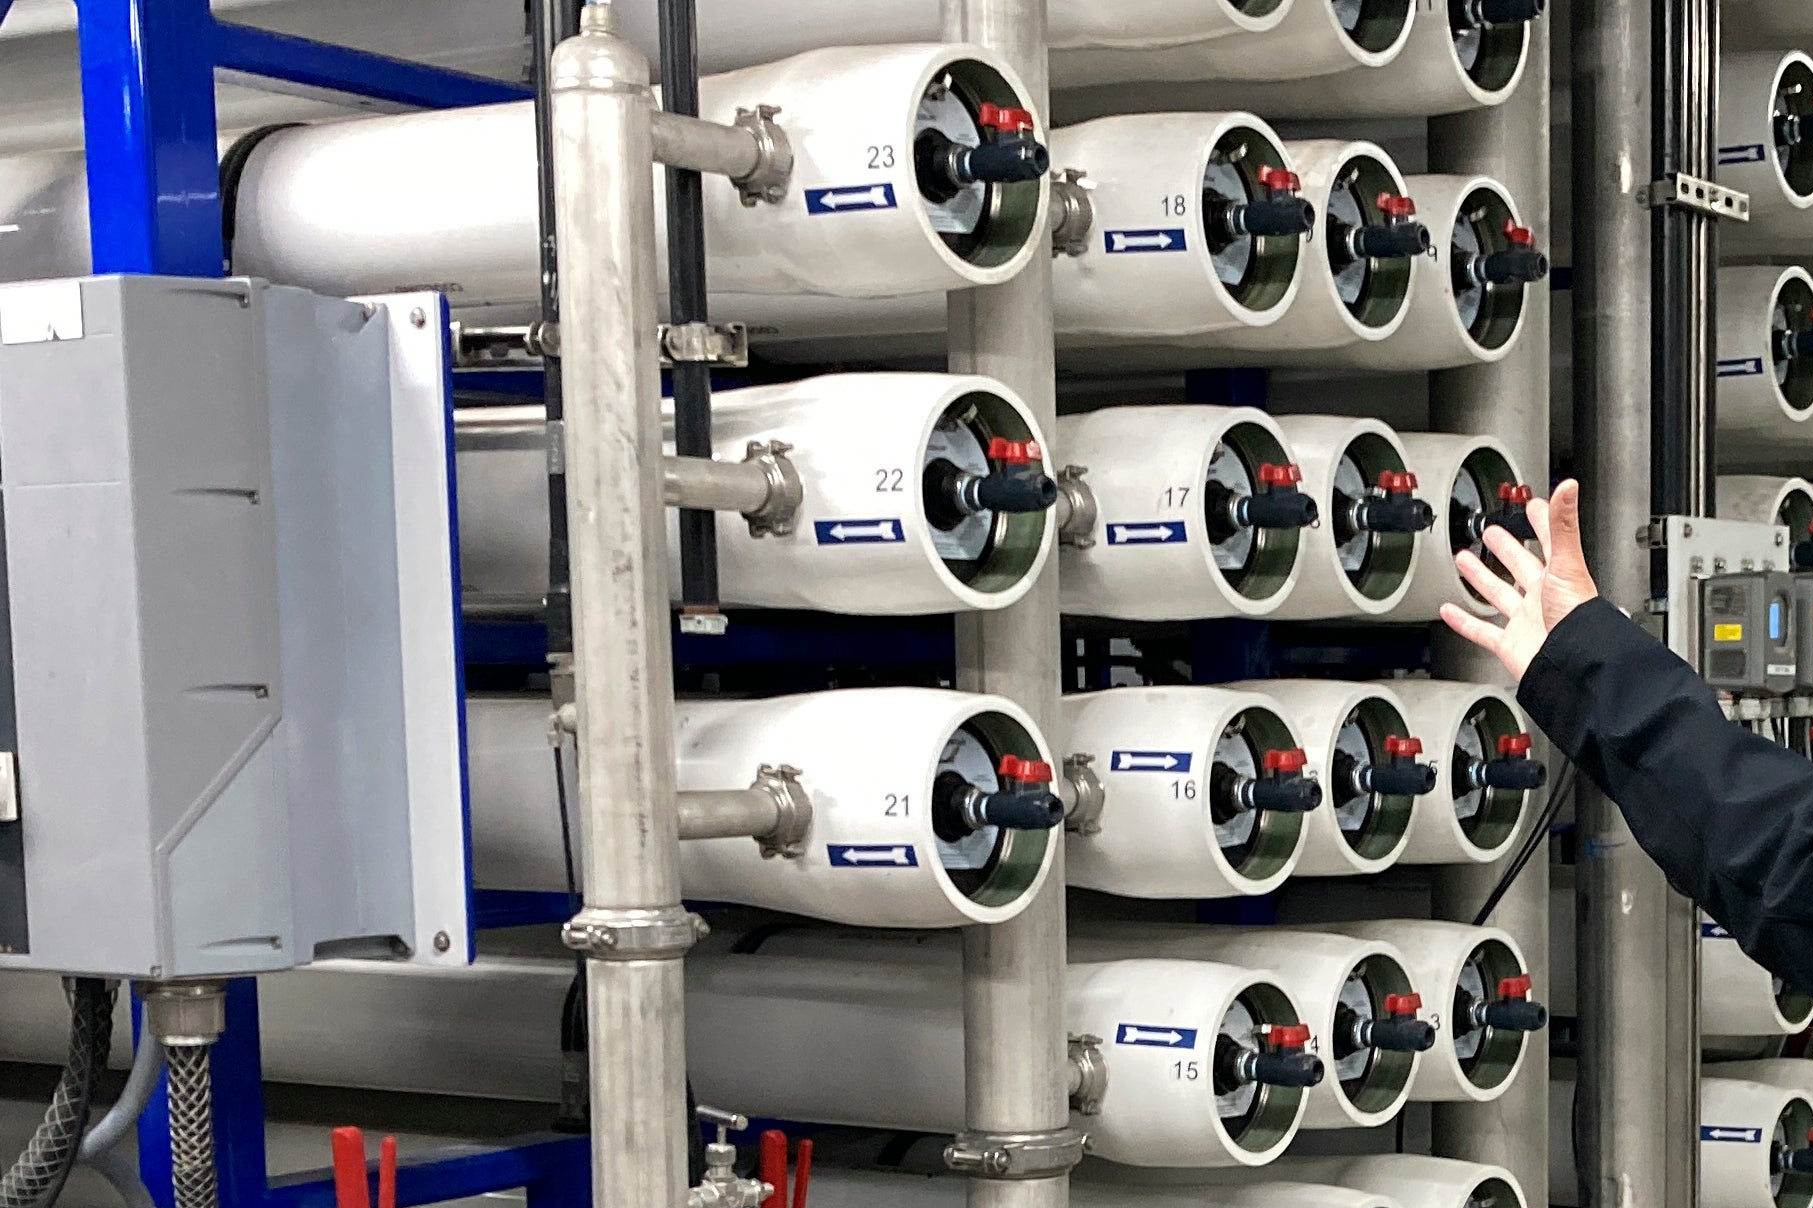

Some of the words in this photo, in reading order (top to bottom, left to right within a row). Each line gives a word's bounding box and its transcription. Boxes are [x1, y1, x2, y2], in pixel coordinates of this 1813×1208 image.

[867, 145, 895, 169] 23
[1161, 194, 1185, 216] 18
[876, 468, 904, 492] 22
[1164, 486, 1190, 507] 17
[1171, 779, 1196, 800] 16
[884, 793, 909, 817] 21
[1430, 1012, 1441, 1030] 3
[1310, 1034, 1321, 1054] 4
[1174, 1060, 1199, 1081] 15
